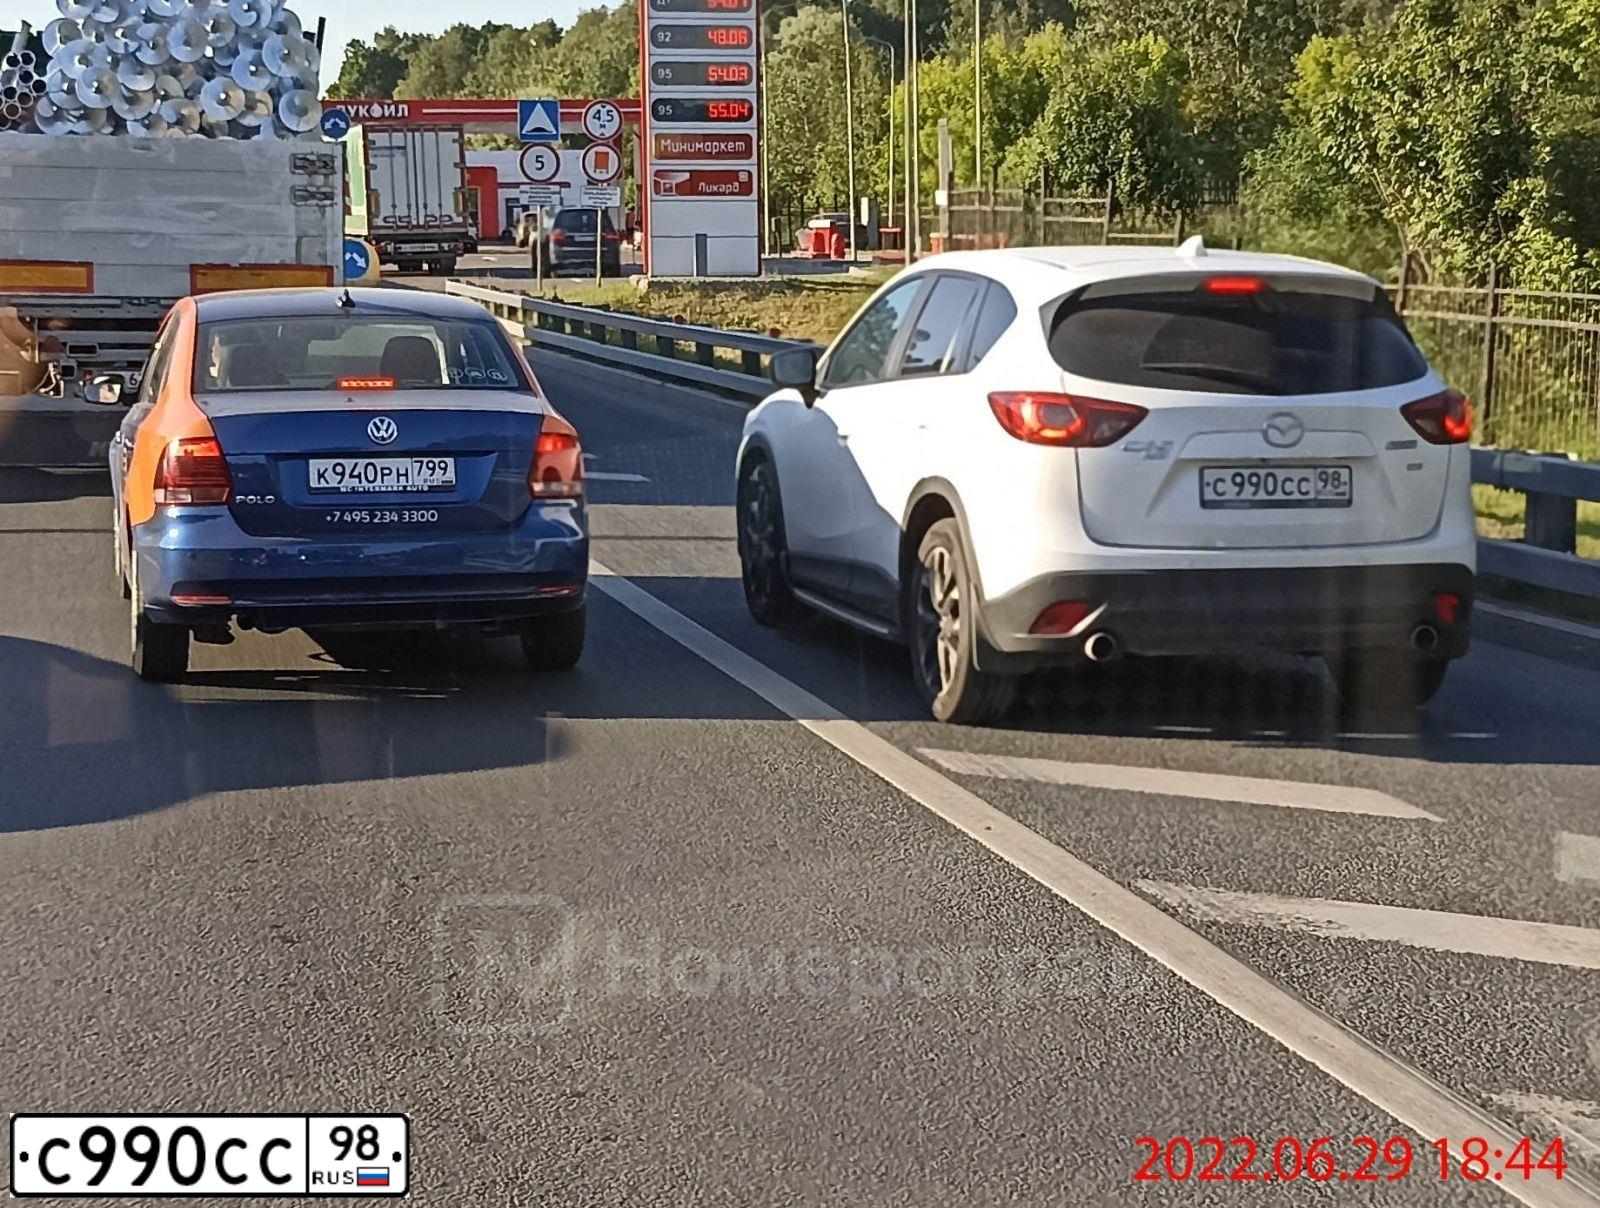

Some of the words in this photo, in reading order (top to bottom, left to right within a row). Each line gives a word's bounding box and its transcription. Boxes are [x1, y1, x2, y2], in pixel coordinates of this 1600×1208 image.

[657, 31, 672, 42] 92
[657, 68, 673, 79] 95
[657, 105, 673, 116] 95
[708, 103, 749, 118] 55.04
[660, 139, 746, 155] Минимаркет
[534, 154, 545, 171] 5
[413, 459, 449, 477] 799
[1318, 470, 1342, 490] 98
[235, 495, 276, 504] POLO
[343, 511, 370, 522] 495
[373, 511, 399, 522] 234
[401, 510, 438, 522] 3300
